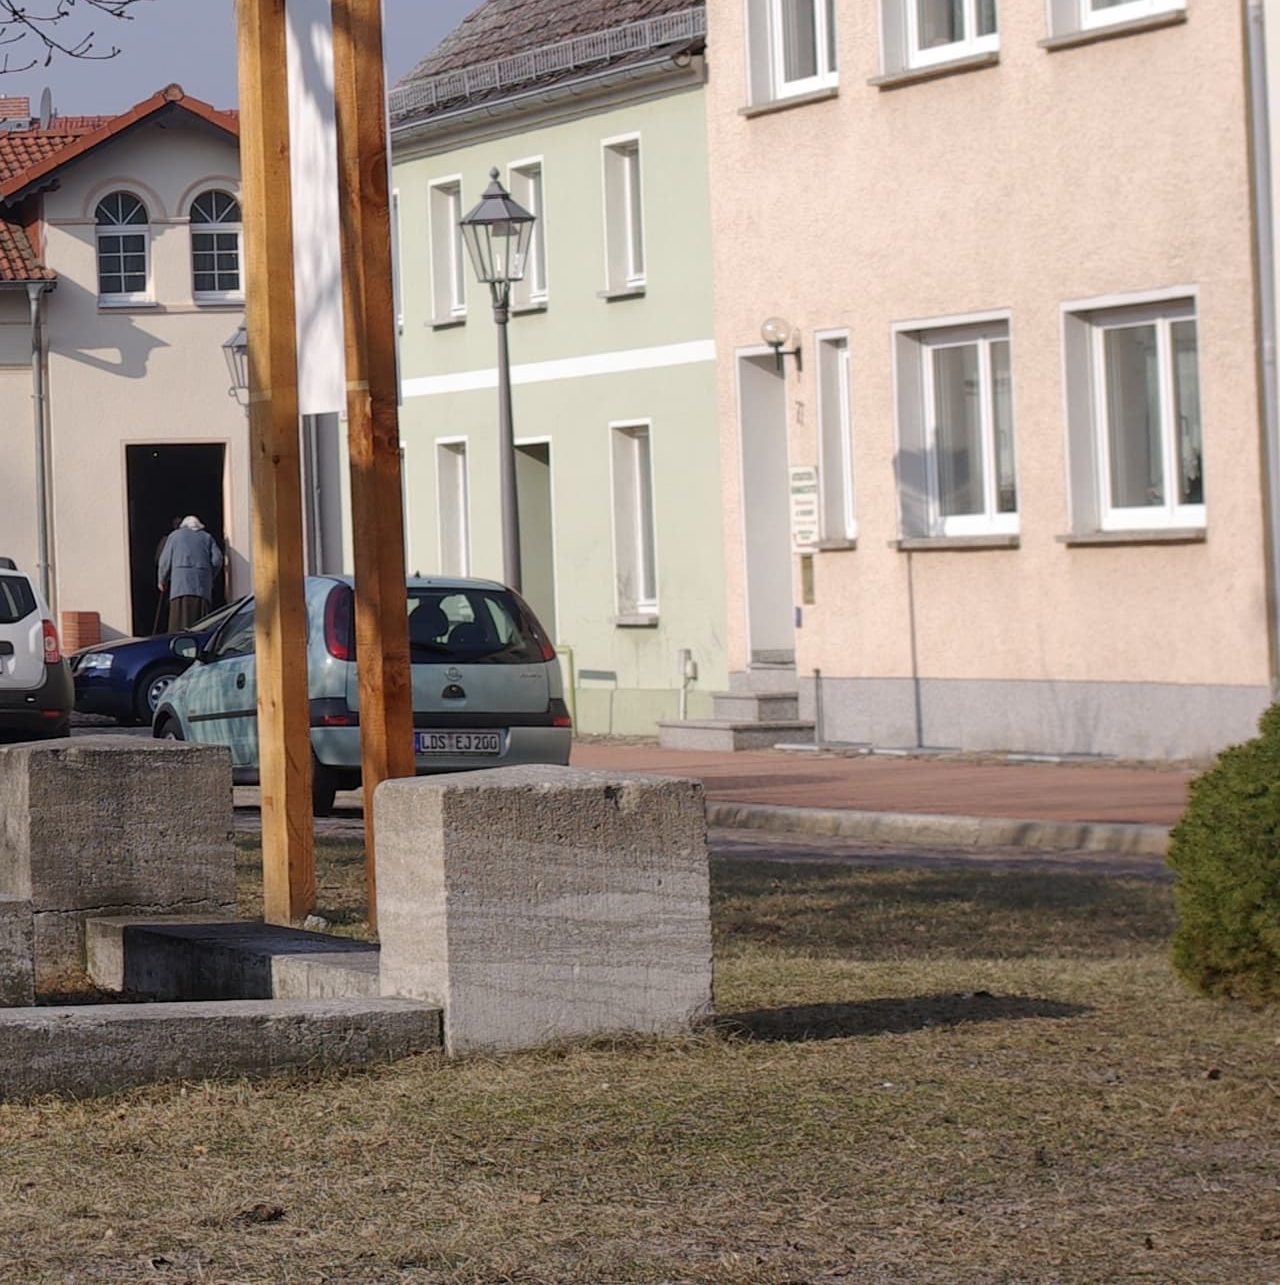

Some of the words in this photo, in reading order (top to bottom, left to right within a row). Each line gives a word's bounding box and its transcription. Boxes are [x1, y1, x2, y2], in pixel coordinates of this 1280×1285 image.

[421, 733, 446, 751] LDS
[455, 734, 472, 750] EJ
[474, 734, 499, 750] 200
